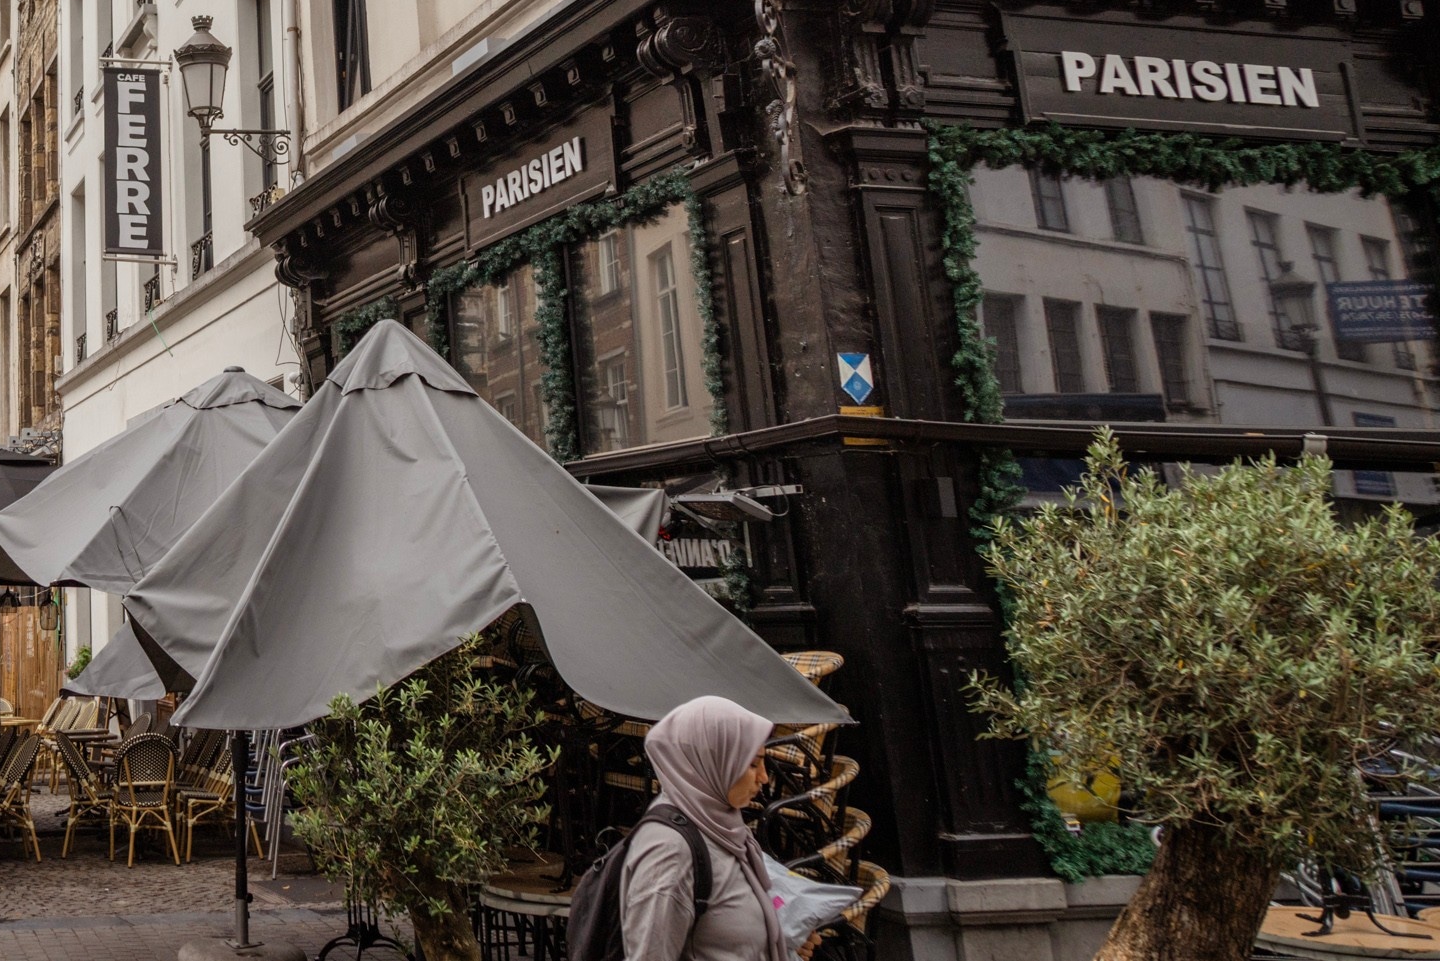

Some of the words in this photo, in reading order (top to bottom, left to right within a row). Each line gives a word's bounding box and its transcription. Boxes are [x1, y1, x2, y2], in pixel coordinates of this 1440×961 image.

[117, 73, 145, 82] CAFE
[1062, 51, 1319, 107] PARISIEN
[116, 82, 151, 249] FERRE
[482, 136, 582, 219] PARISIEN
